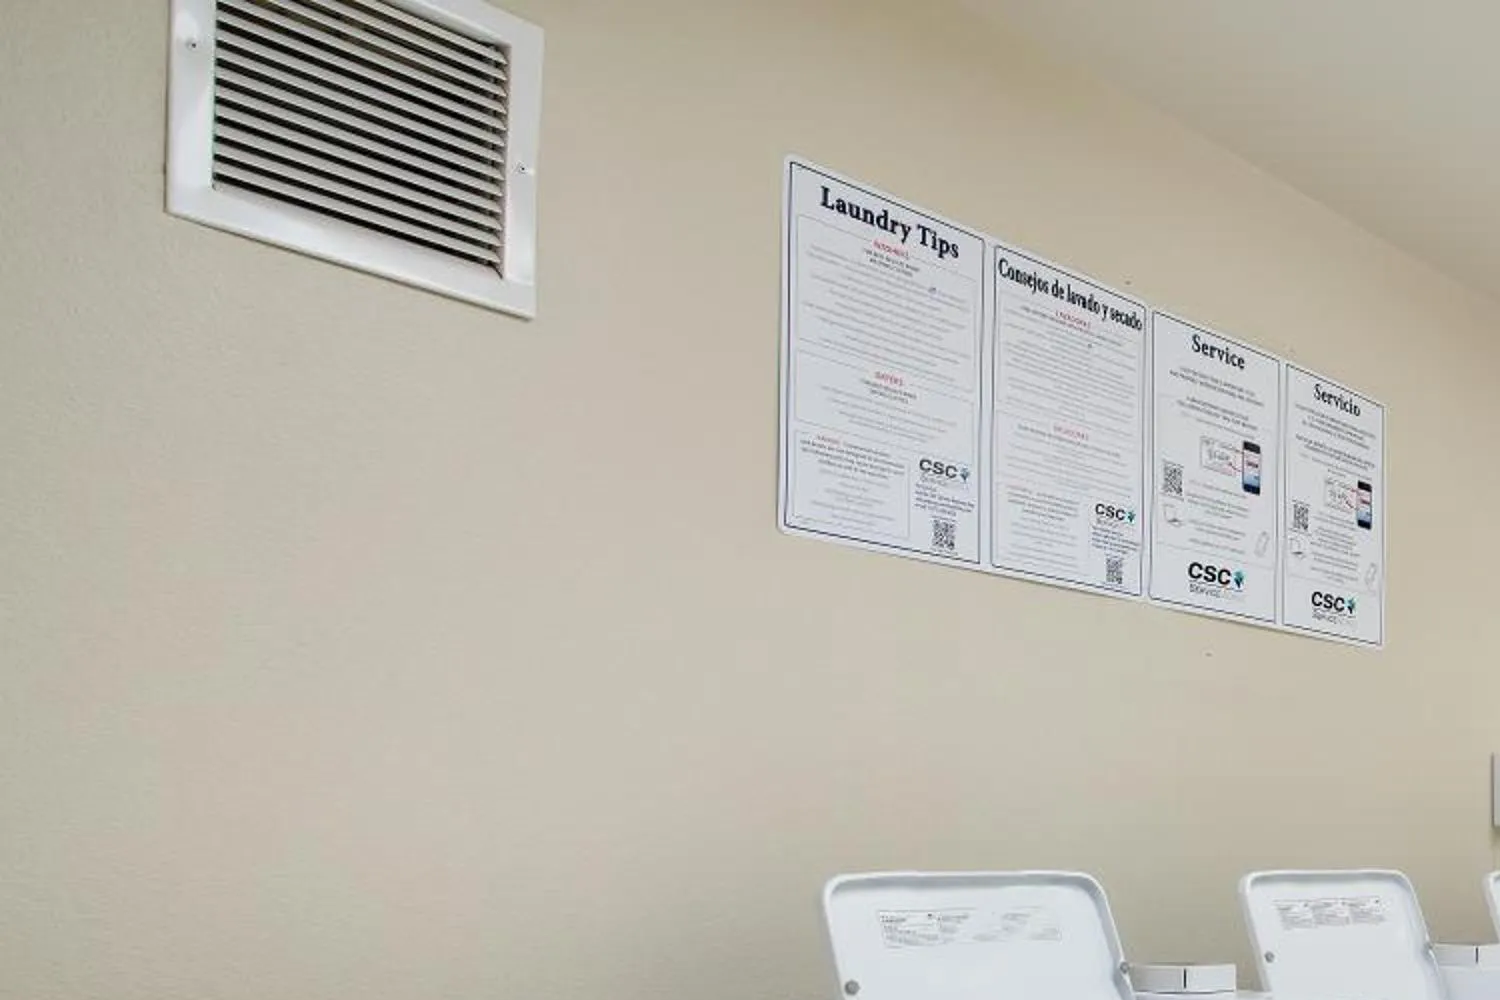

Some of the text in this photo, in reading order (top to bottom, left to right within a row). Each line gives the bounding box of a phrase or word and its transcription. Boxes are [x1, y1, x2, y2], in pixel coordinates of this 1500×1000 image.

[819, 185, 912, 244] Laundry
[917, 224, 960, 259] Tips
[998, 256, 1050, 295] Consejos
[1051, 279, 1065, 300] de
[1066, 283, 1101, 315] lavado
[1102, 303, 1110, 322] y
[1110, 306, 1143, 332] secado
[1191, 333, 1246, 371] Service
[1313, 383, 1361, 418] Servicio
[918, 458, 959, 479] CSC
[1094, 503, 1127, 521] CSC
[1187, 561, 1232, 586] CSC
[1311, 591, 1346, 614] CSC
